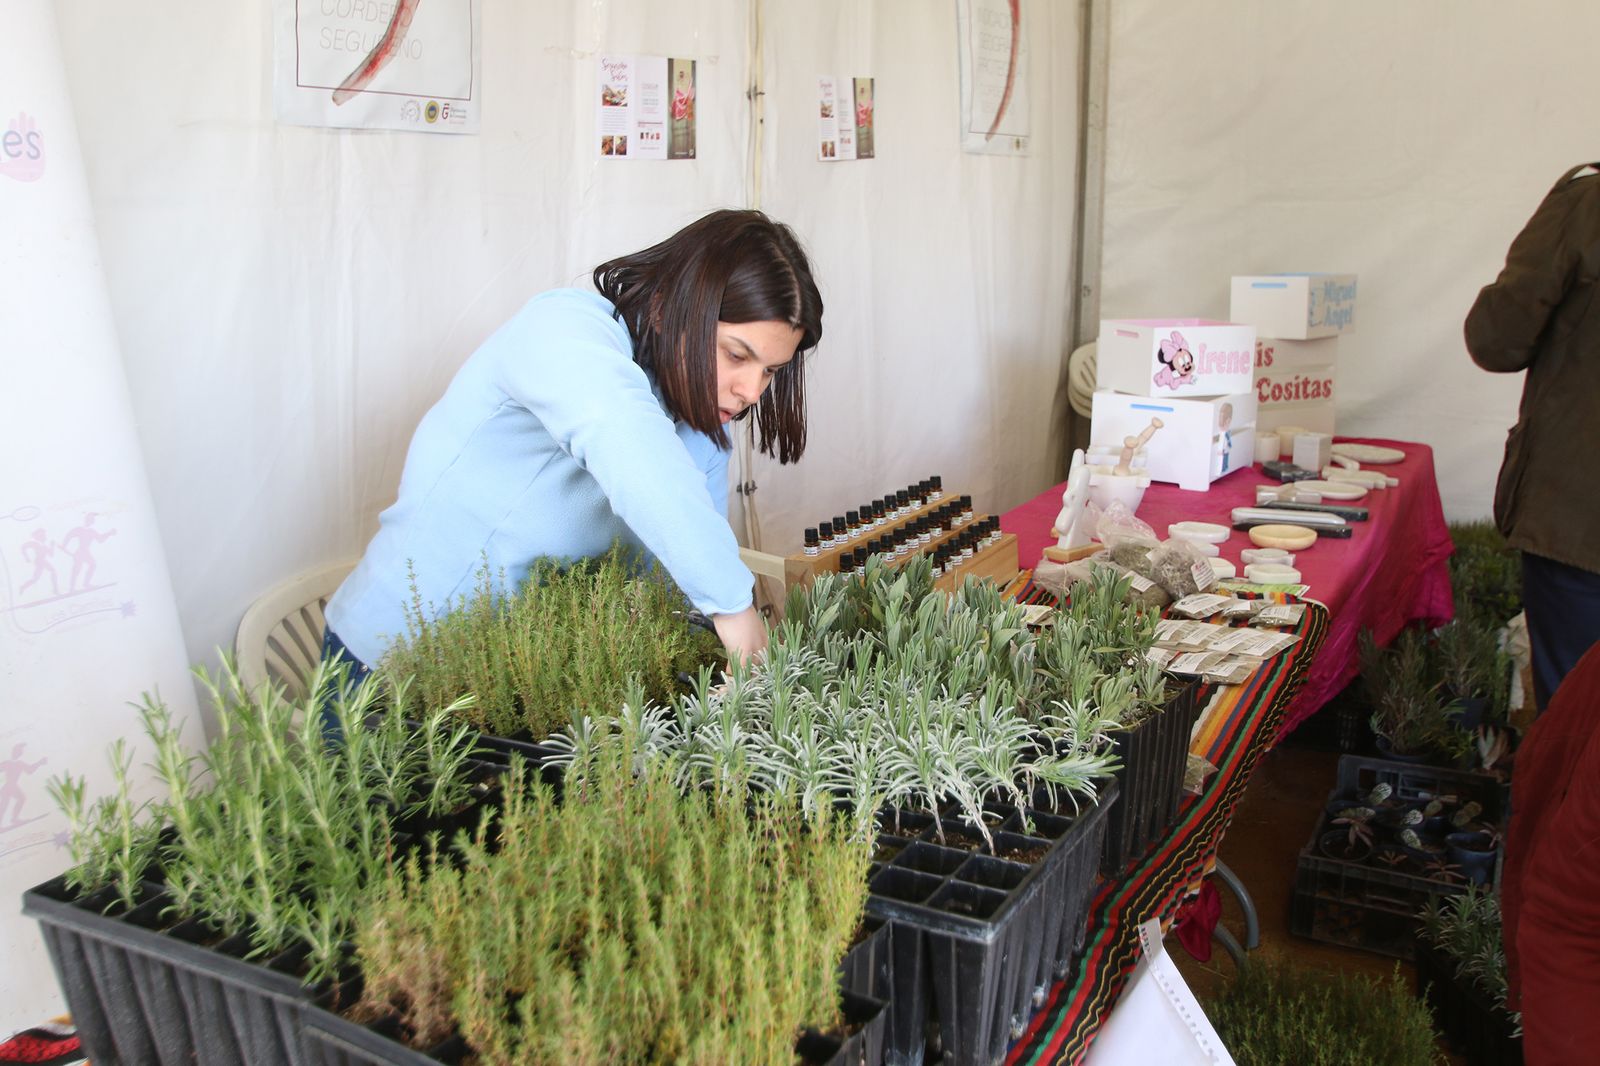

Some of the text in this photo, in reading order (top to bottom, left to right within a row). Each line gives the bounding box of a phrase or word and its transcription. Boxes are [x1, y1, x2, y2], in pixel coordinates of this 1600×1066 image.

[2, 129, 41, 160] es
[1197, 342, 1251, 375] Irene
[1254, 341, 1275, 368] is
[1255, 375, 1333, 403] Cositas
